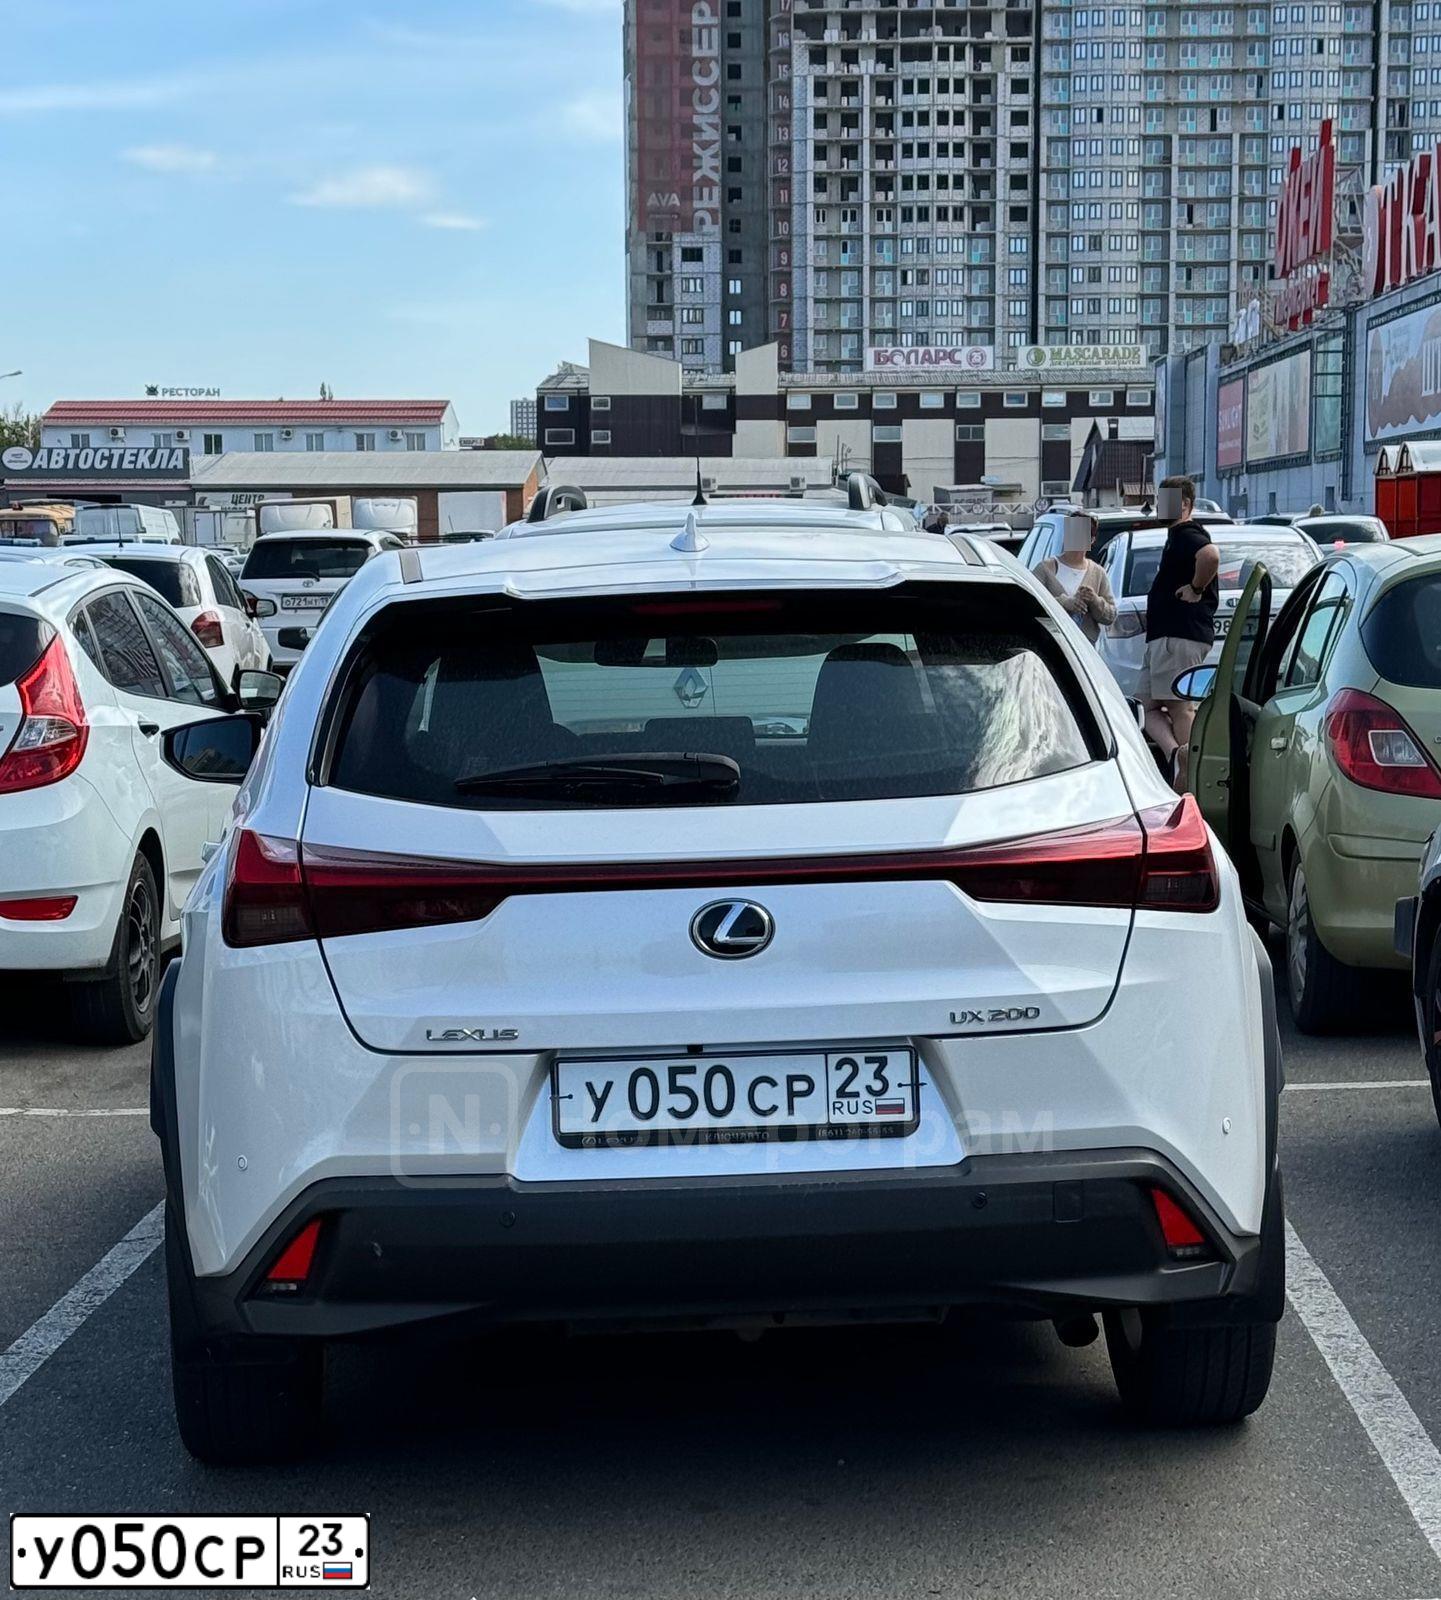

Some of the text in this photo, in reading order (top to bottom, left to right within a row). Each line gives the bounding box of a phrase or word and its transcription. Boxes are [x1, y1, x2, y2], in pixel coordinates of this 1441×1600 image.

[778, 64, 789, 77] 15
[778, 95, 790, 108] 14
[692, 2, 720, 236] РЕЖИССЕР
[777, 127, 789, 140] 13
[777, 158, 789, 171] 12
[780, 190, 789, 203] 11
[778, 221, 789, 235] 10
[780, 251, 788, 265] 9
[780, 283, 788, 297] 8
[780, 313, 788, 327] 7
[780, 345, 788, 358] 6
[162, 387, 220, 397] РЕСТОРАН
[32, 448, 183, 470] АВТОСТЕКЛА
[949, 1006, 1040, 1025] UX 200
[426, 1028, 519, 1041] LEXUS
[835, 1055, 889, 1099] 23
[832, 1100, 874, 1115] RUS
